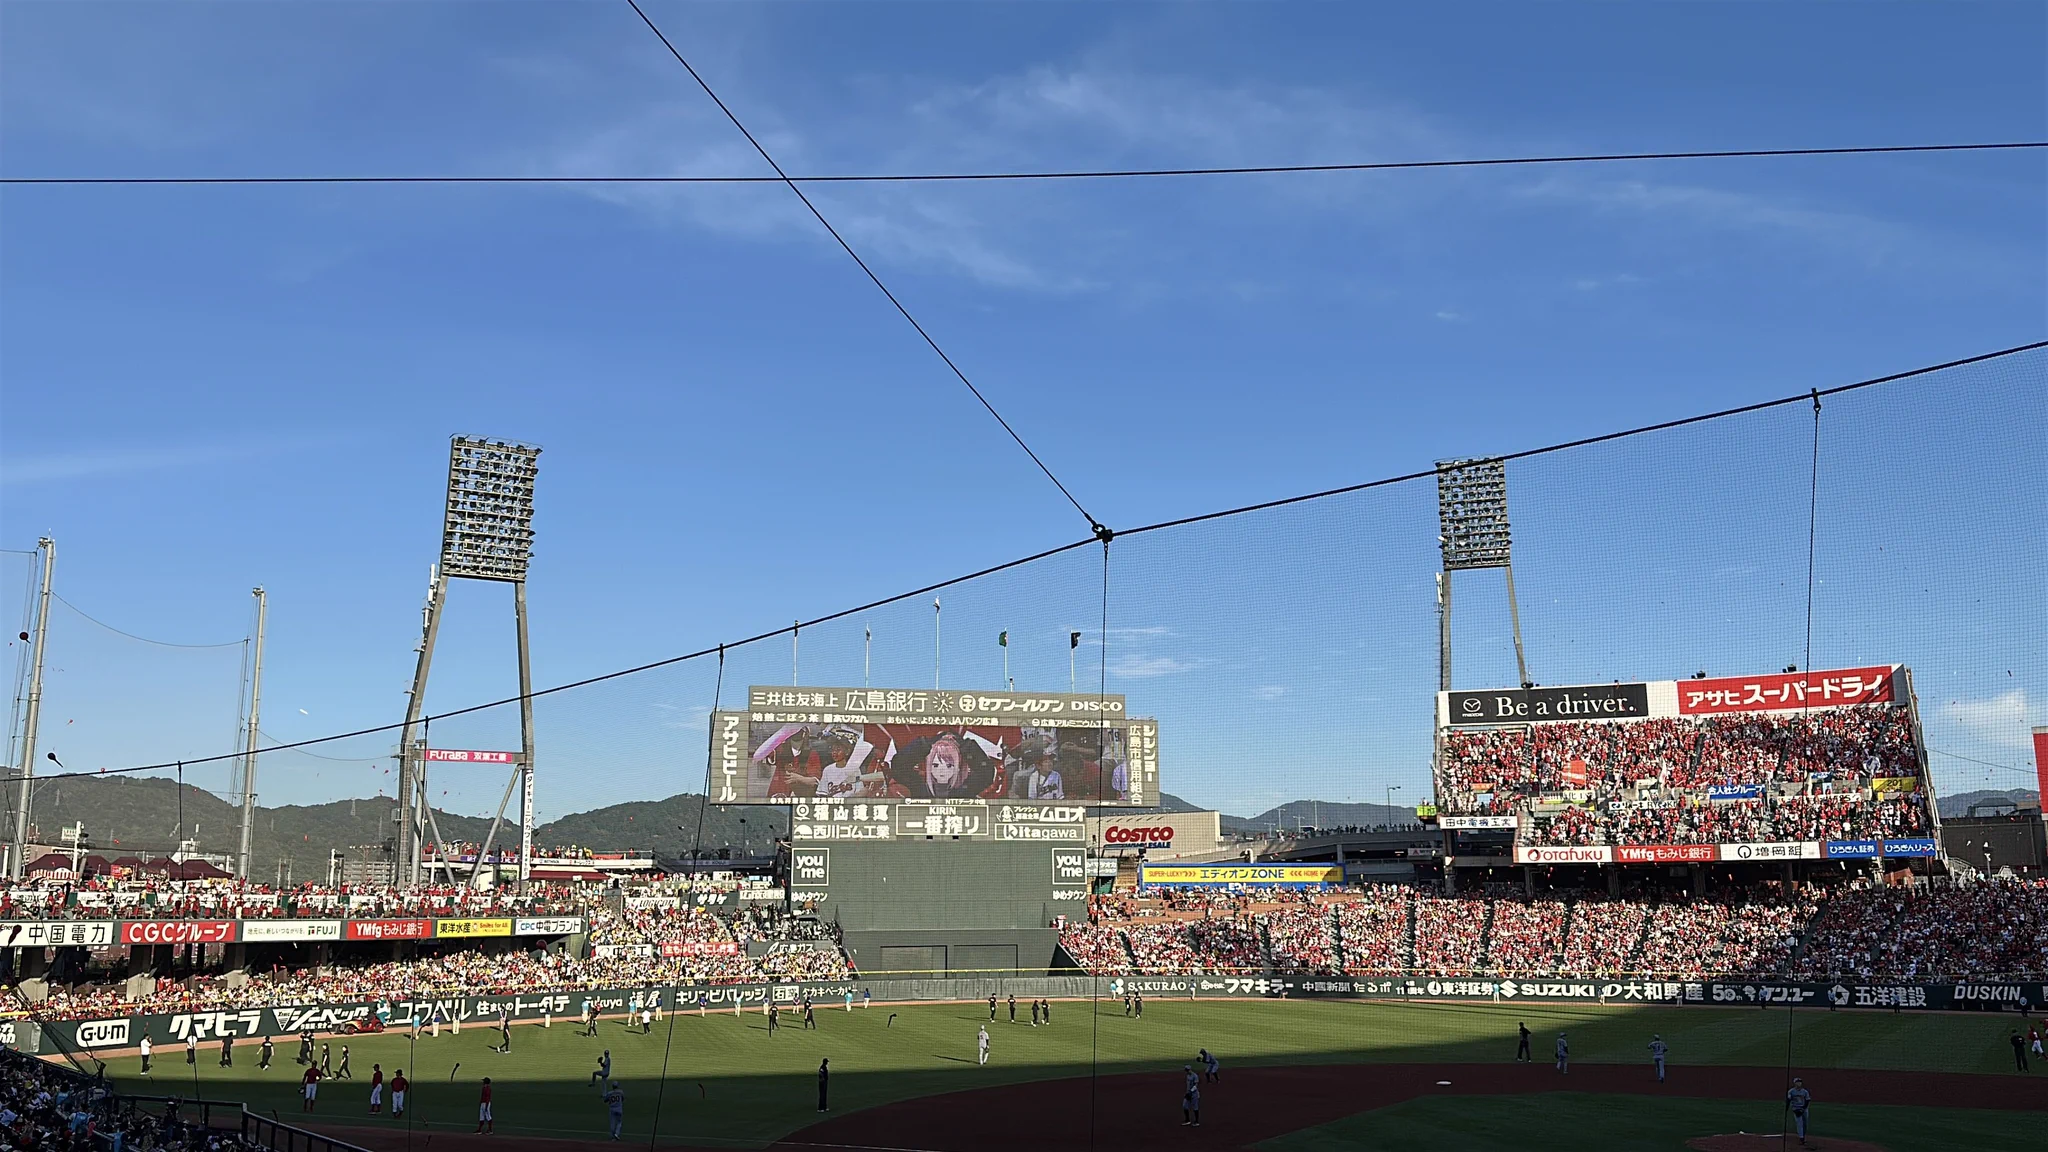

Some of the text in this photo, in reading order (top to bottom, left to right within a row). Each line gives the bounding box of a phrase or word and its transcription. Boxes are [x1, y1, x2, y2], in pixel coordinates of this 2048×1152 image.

[1687, 675, 1882, 708] アサヒ スーパードライ
[752, 692, 839, 707] 三井住友海上
[845, 690, 928, 712] 広島銀行
[1071, 701, 1122, 711] DISCO
[1495, 693, 1636, 717] Be a driver.
[719, 716, 739, 802] アサヒビール
[1129, 724, 1142, 805] 広島市信用組合
[929, 807, 957, 815] KIRIN
[813, 825, 890, 839] 西川ゴム工業
[905, 815, 979, 835] 一番搾り
[1003, 825, 1077, 840] Kitagawa
[1656, 847, 1712, 860] もみじ銀行
[1755, 846, 1803, 857] 増岡組
[796, 855, 823, 869] you
[1056, 855, 1081, 869] you
[801, 867, 825, 878] me
[1061, 867, 1083, 877] me
[1200, 870, 1248, 879] エディオン
[1252, 869, 1284, 879] ZONE
[791, 892, 828, 902] ゆめタウン
[1052, 891, 1086, 900] ゆめタウン
[129, 922, 229, 942] CGCグループ
[317, 926, 336, 935] FUJI
[356, 923, 423, 938] YMfg もみじ銀行
[440, 922, 470, 934] 東洋水産
[536, 920, 580, 932] 中電プラント
[29, 924, 105, 944] 中国電力
[1225, 978, 1294, 994] フマキラー
[1442, 981, 1494, 996] 東洋証券
[1521, 984, 1595, 997] SUZUKI
[1954, 985, 2021, 1000] DUSKIN
[676, 987, 766, 1004] キリンビバレッジ
[1855, 986, 1927, 1006] 五洋建設
[169, 1009, 261, 1039] クマヒラ
